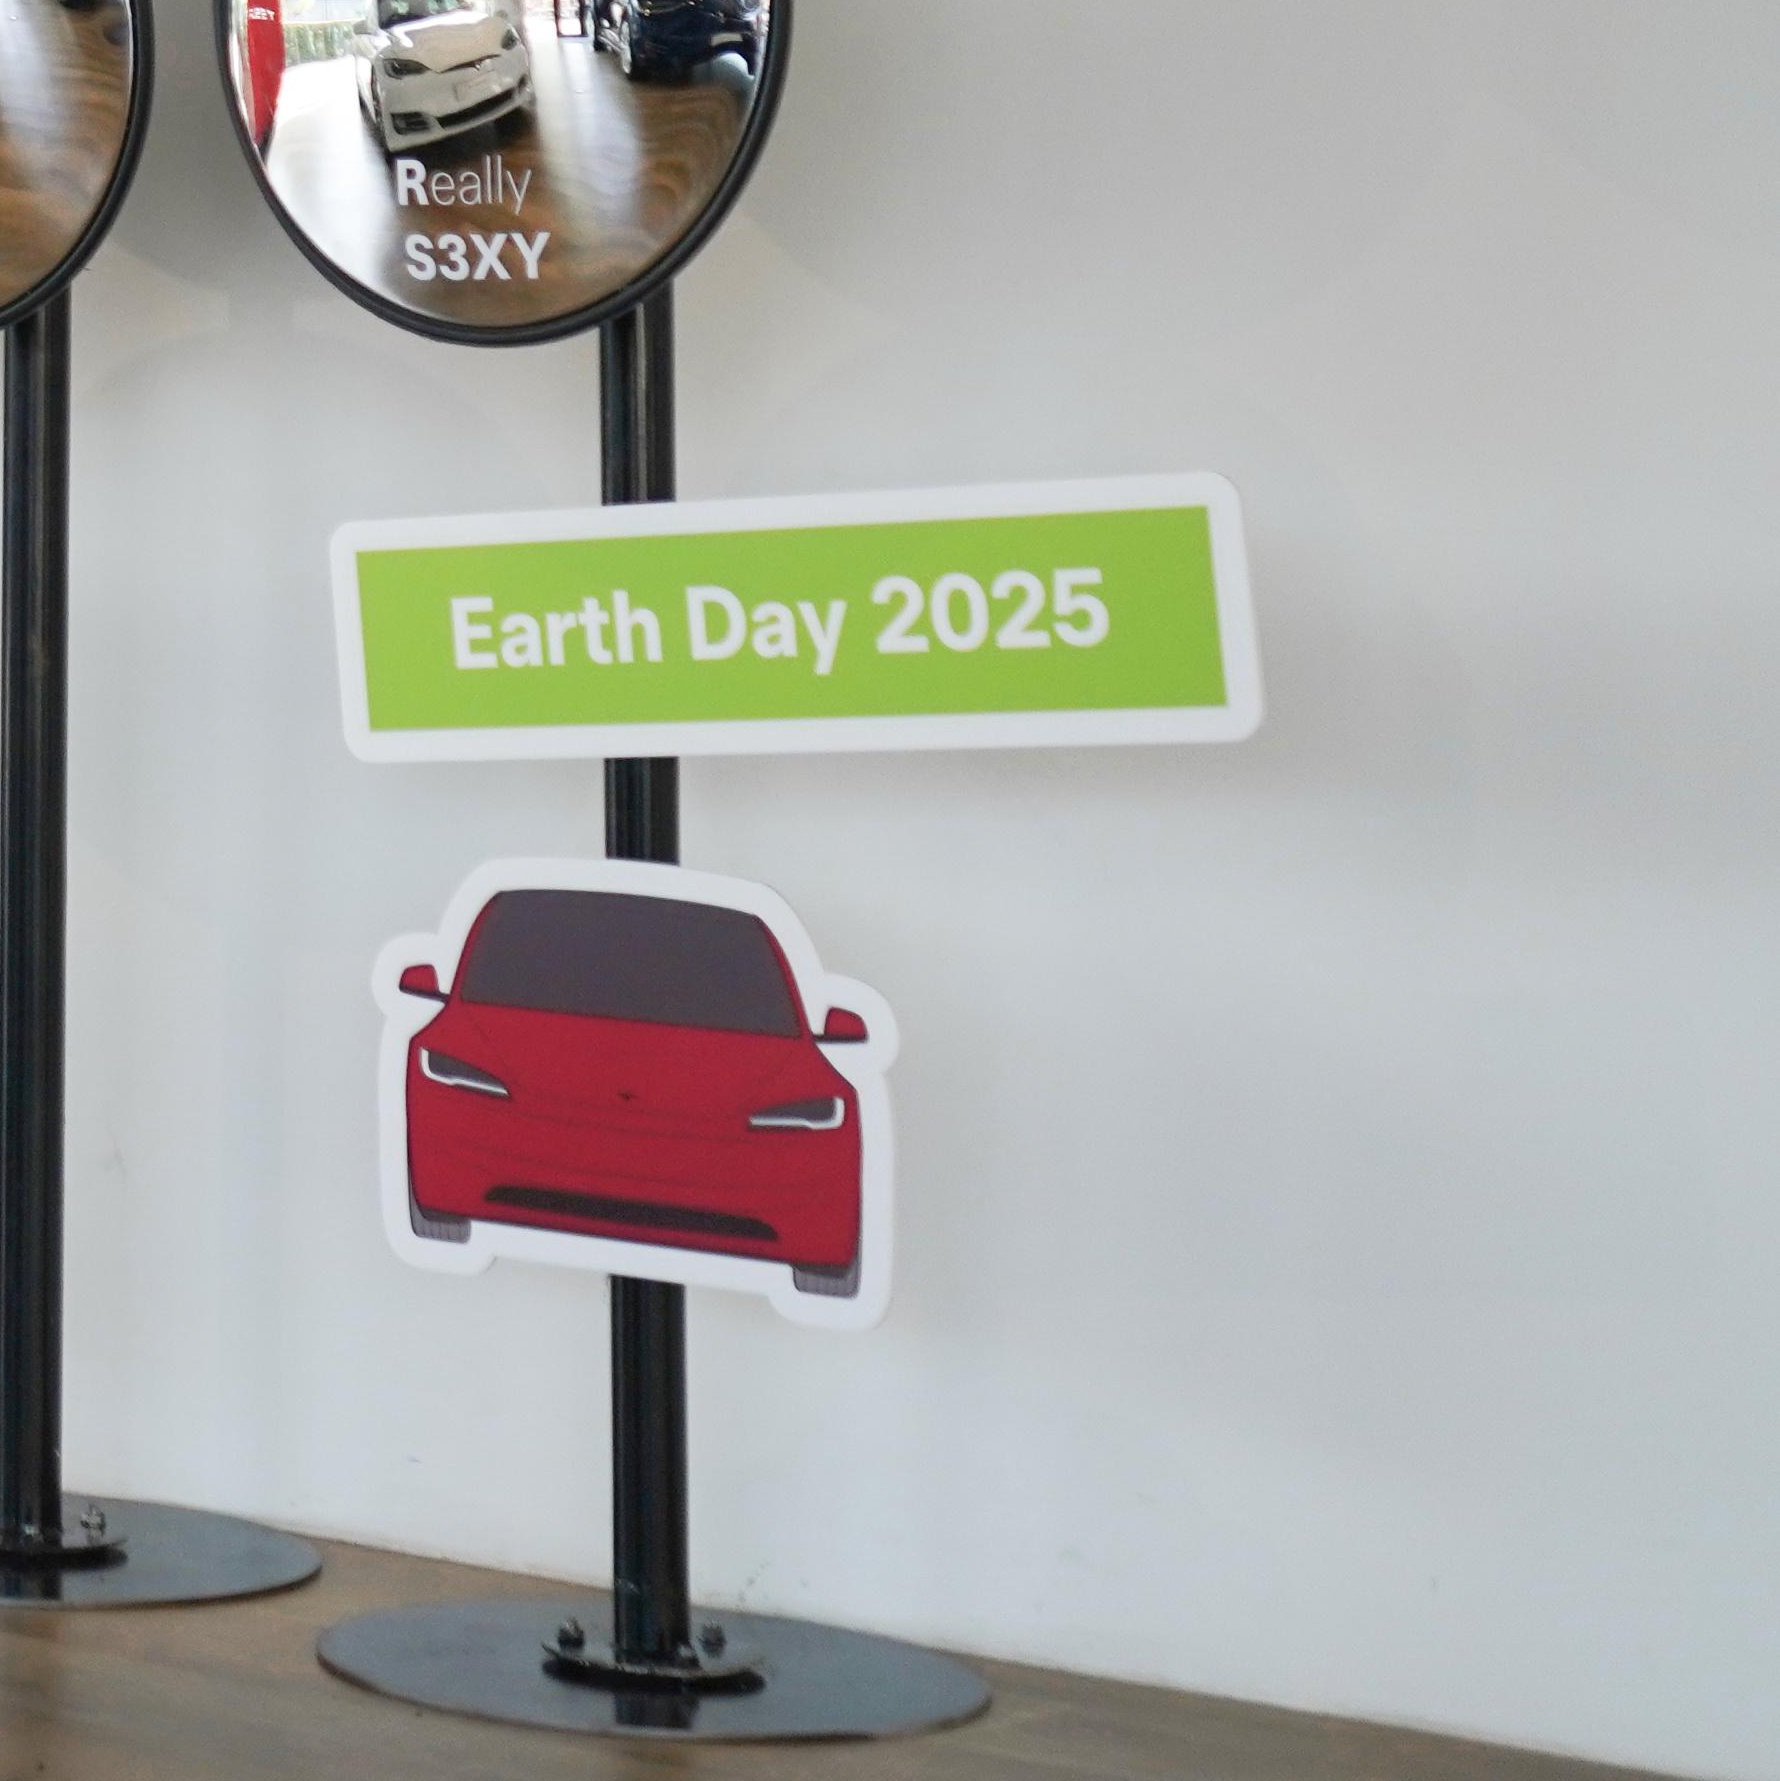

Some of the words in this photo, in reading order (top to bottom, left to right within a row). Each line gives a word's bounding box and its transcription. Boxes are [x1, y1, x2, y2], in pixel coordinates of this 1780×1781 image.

[396, 155, 532, 215] Really
[405, 232, 550, 281] S3XY
[449, 590, 662, 670] Earth
[686, 585, 846, 676] Day
[871, 567, 1110, 654] 2025
